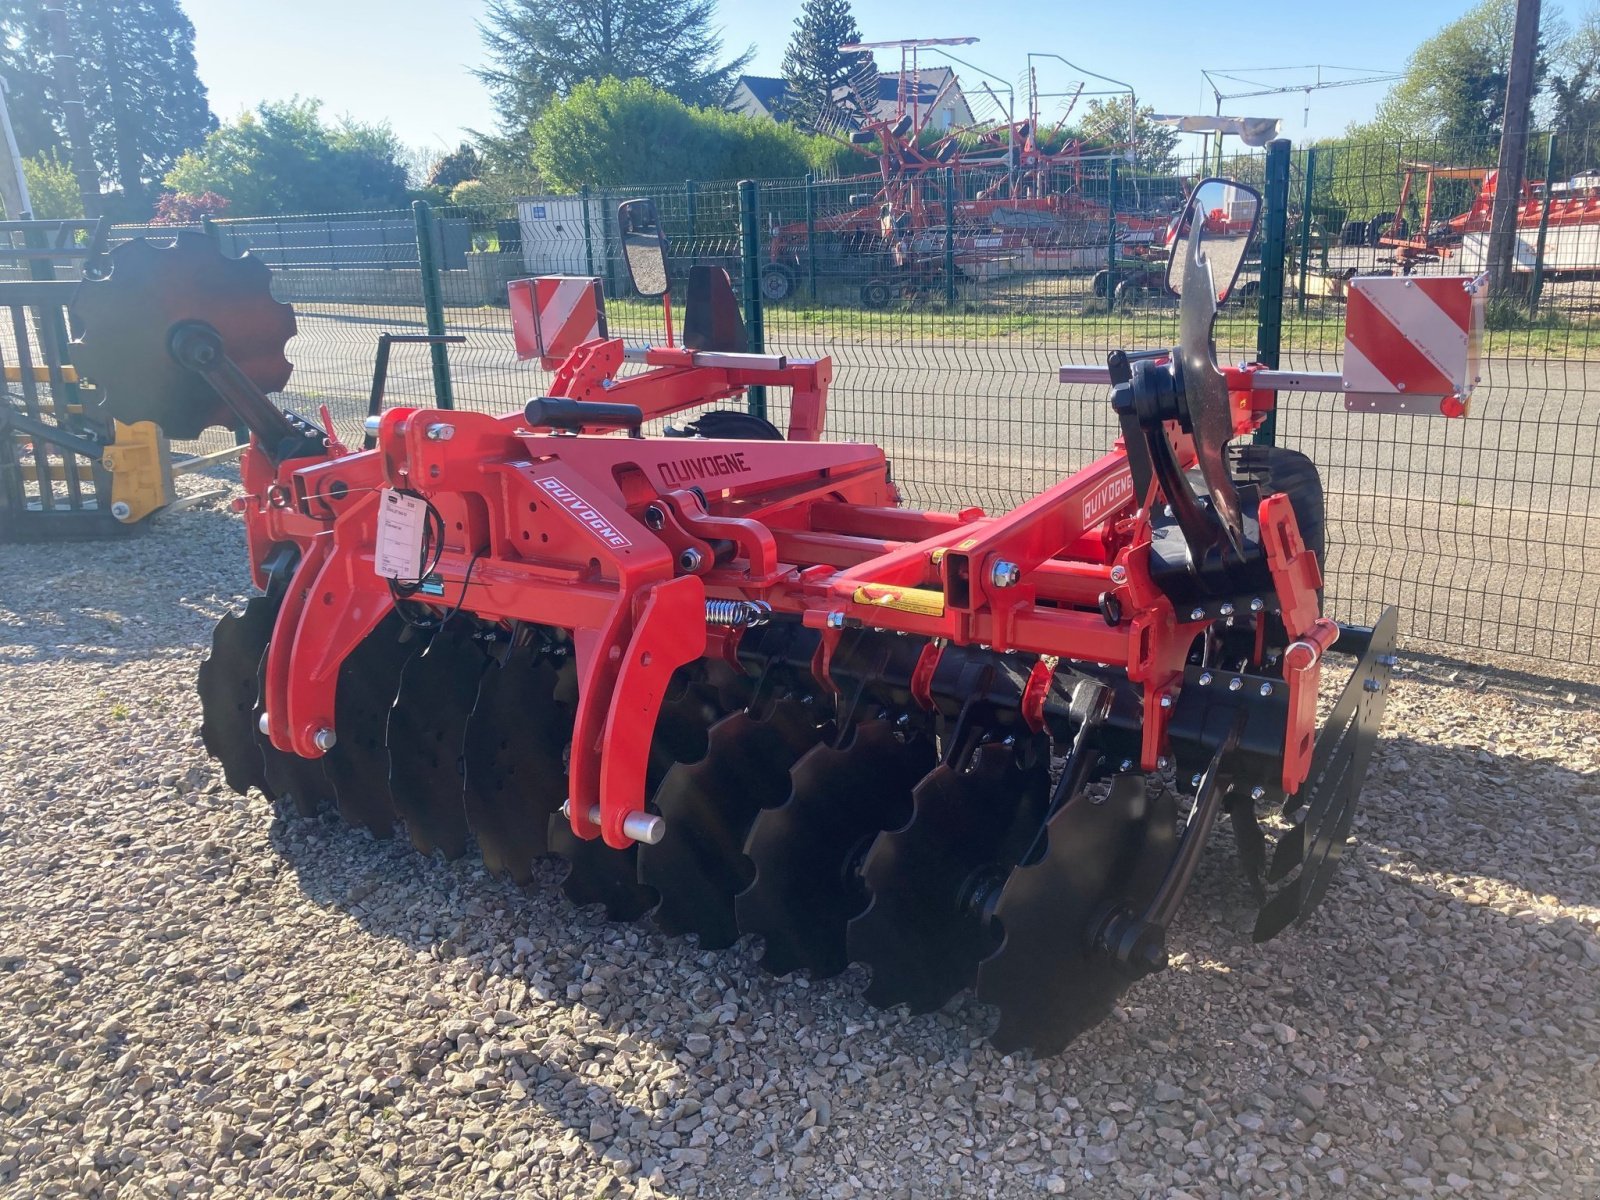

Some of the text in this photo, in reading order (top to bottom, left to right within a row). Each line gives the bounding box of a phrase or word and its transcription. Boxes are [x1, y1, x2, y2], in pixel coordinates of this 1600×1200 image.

[657, 452, 751, 489] QUIVOGNE
[543, 480, 625, 545] QUIVOGNE
[1085, 474, 1132, 519] QUIVOGNE
